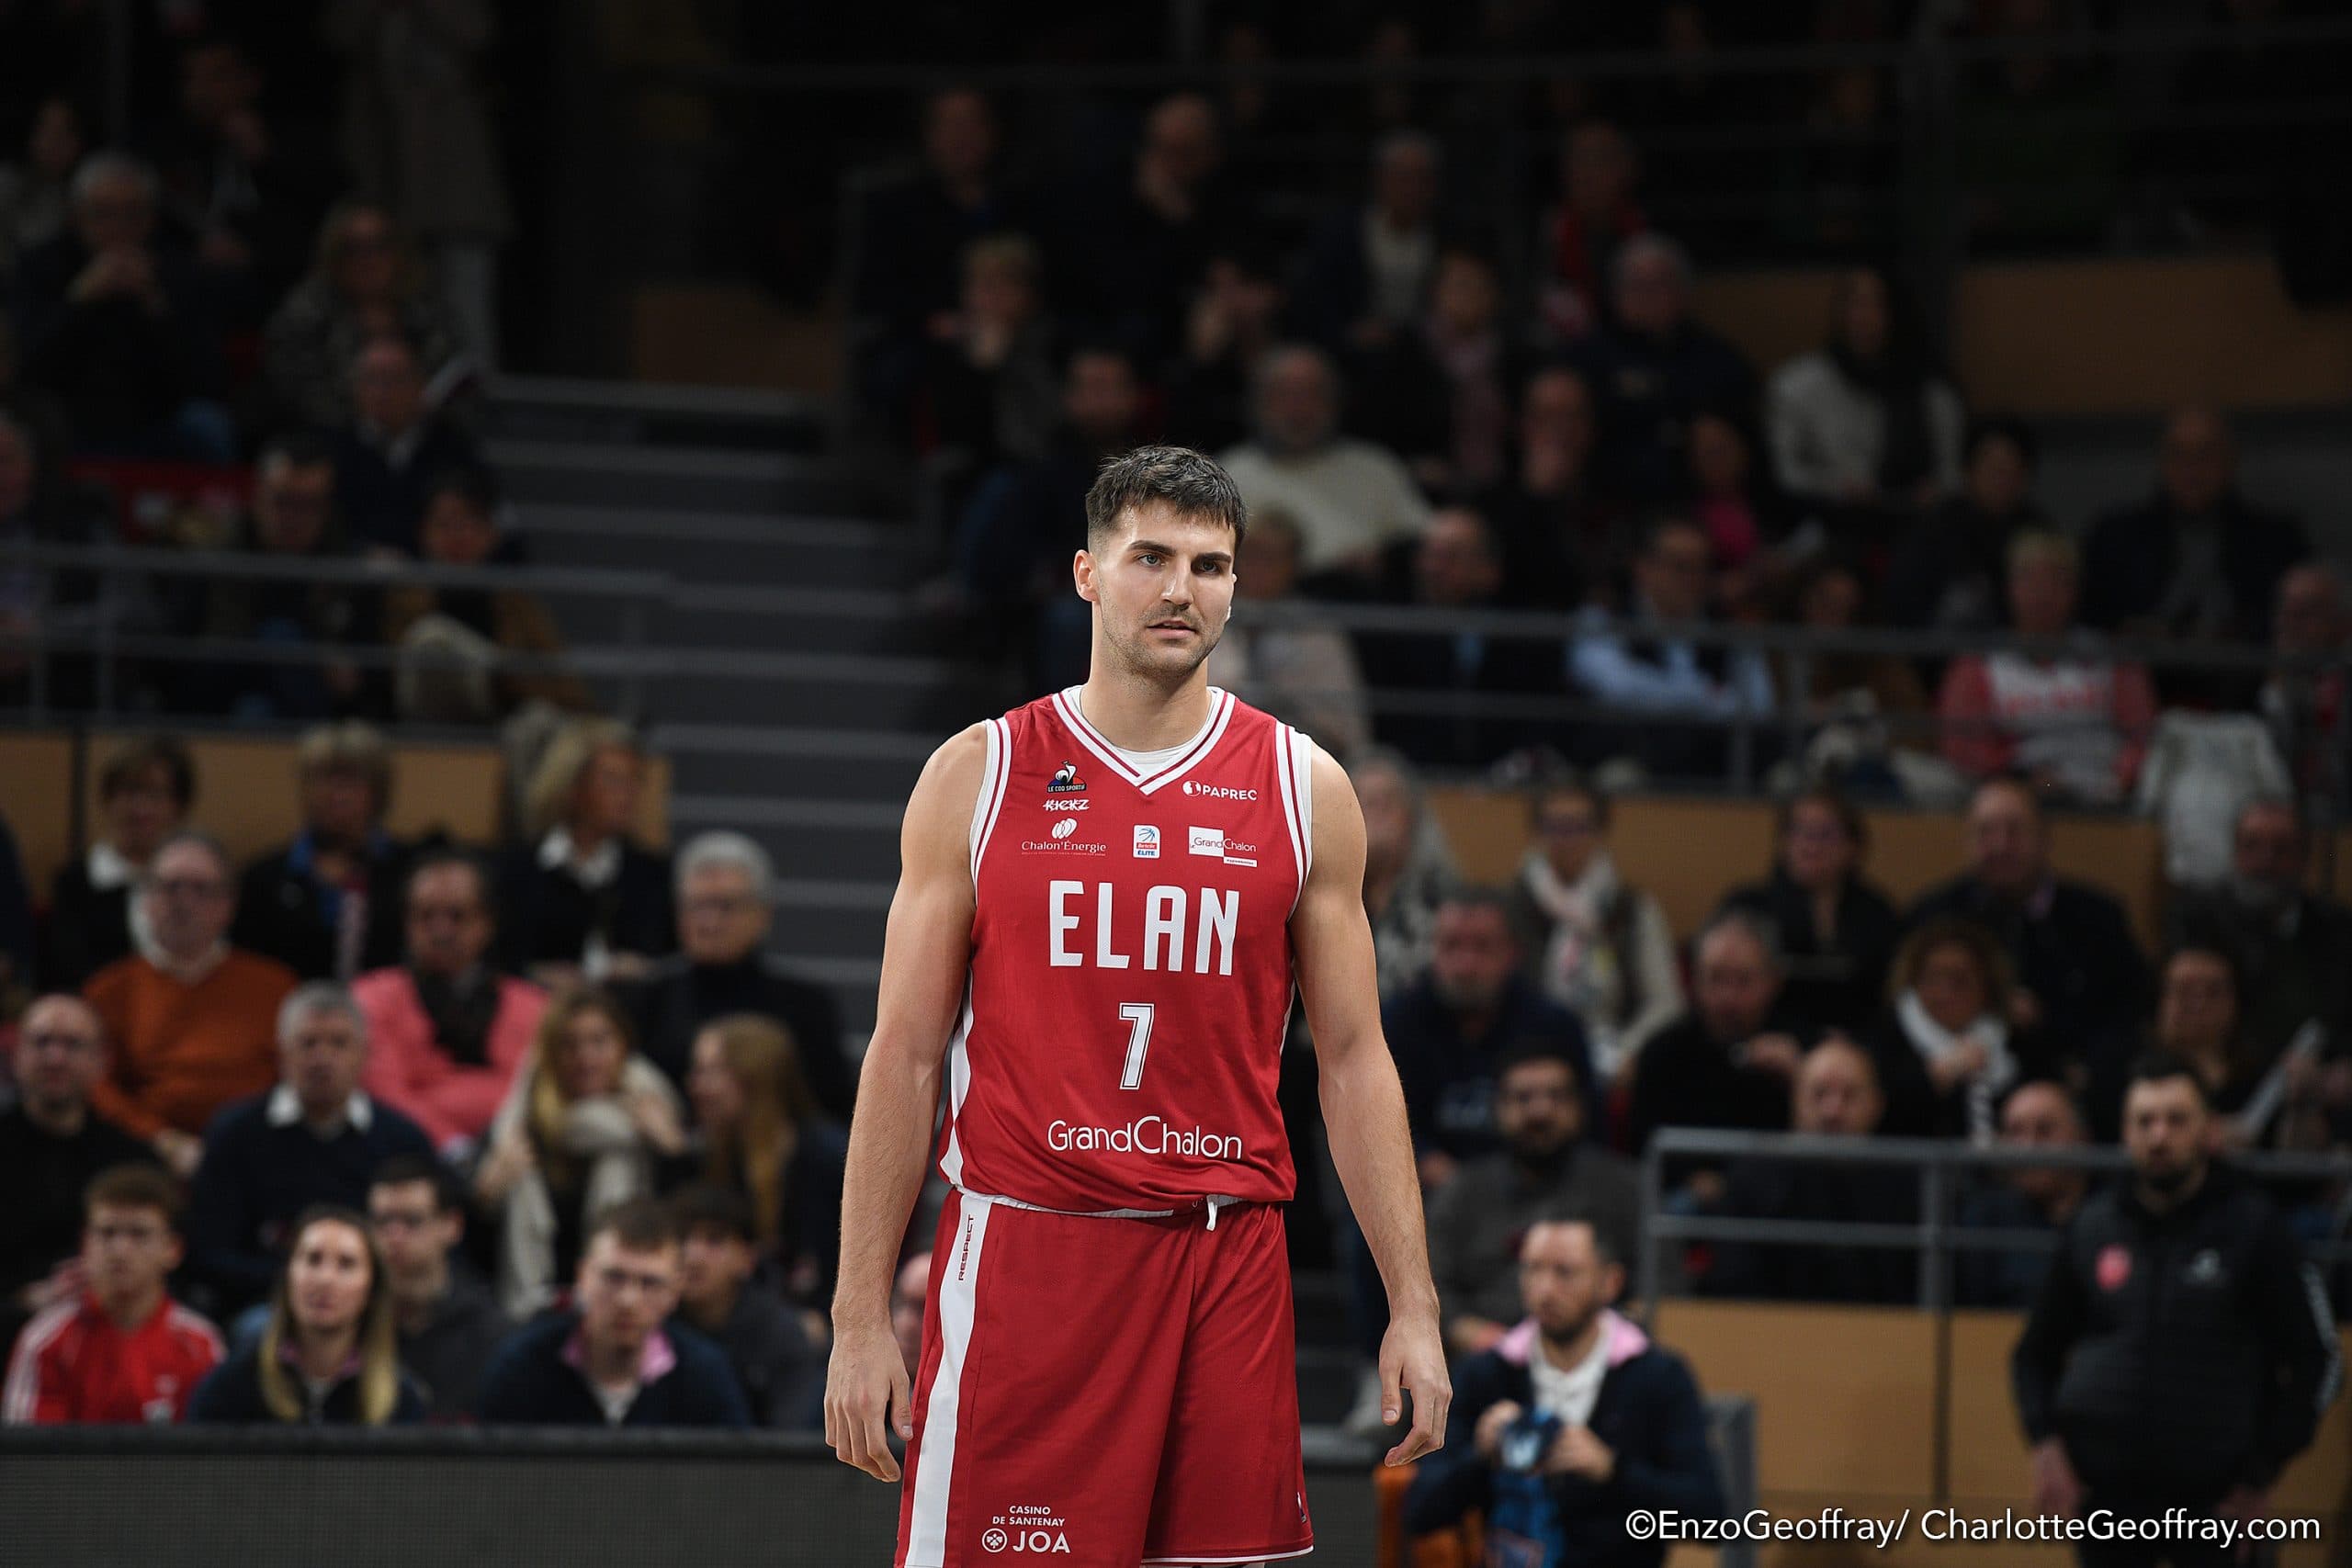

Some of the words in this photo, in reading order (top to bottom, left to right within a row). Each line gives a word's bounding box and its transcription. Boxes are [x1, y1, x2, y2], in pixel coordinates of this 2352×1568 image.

[1202, 784, 1258, 801] PAPREC
[1042, 798, 1090, 812] KICKZ
[1022, 840, 1107, 853] Chalon'Énergie
[1049, 880, 1240, 976] ELAN
[1118, 1002, 1155, 1090] 7
[1047, 1116, 1242, 1159] GrandChalon
[957, 1213, 975, 1281] RESPECT
[1009, 1506, 1051, 1516] CASINO
[992, 1516, 1006, 1525] DE
[1009, 1516, 1066, 1527] SANTENAY
[1012, 1530, 1071, 1553] JOA
